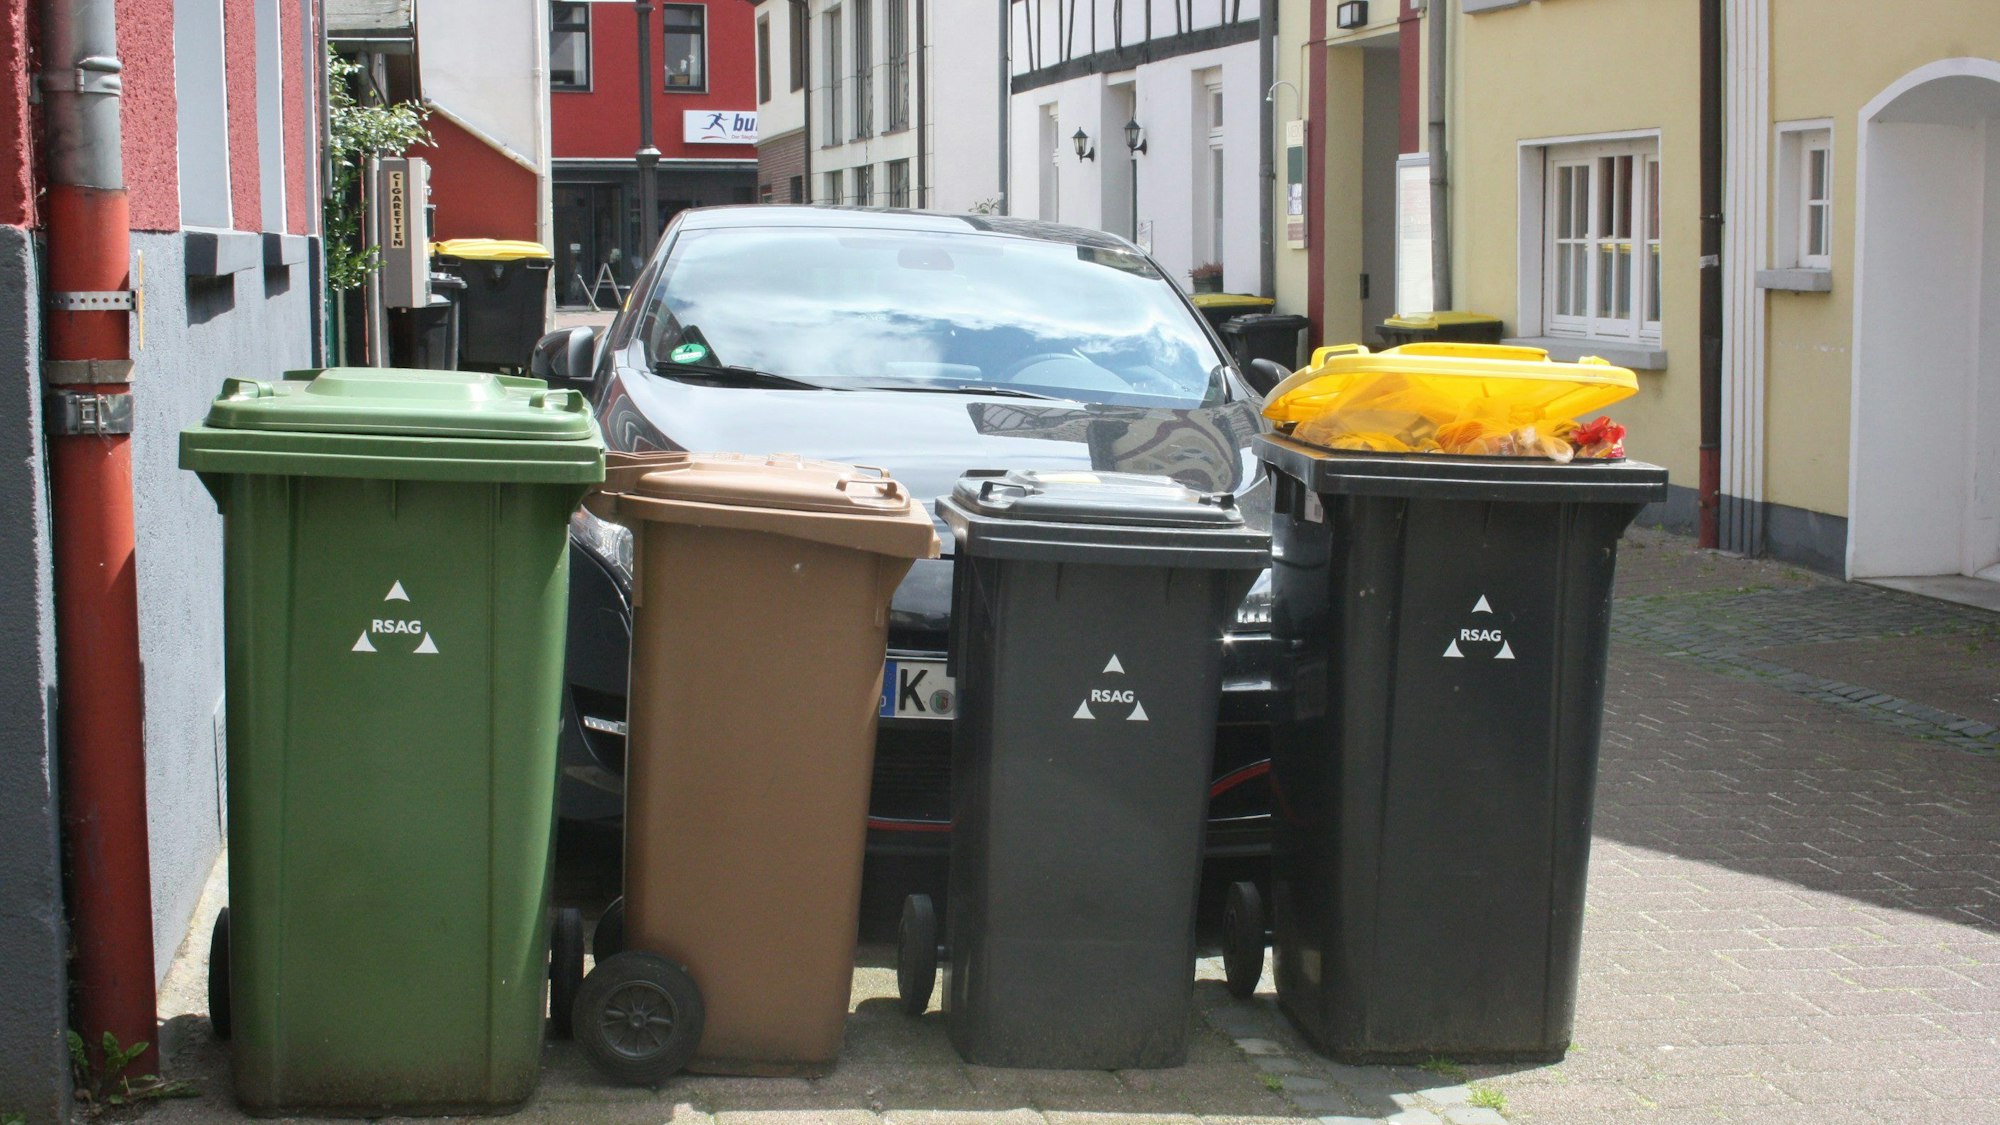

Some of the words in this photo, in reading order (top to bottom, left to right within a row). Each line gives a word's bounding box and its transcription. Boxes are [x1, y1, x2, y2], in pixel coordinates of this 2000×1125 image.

[733, 113, 757, 131] bu
[392, 173, 403, 247] CIGARETTEN
[372, 619, 422, 634] RSAG
[1460, 628, 1502, 642] RSAG
[898, 668, 928, 712] K
[1091, 689, 1134, 703] RSAG
